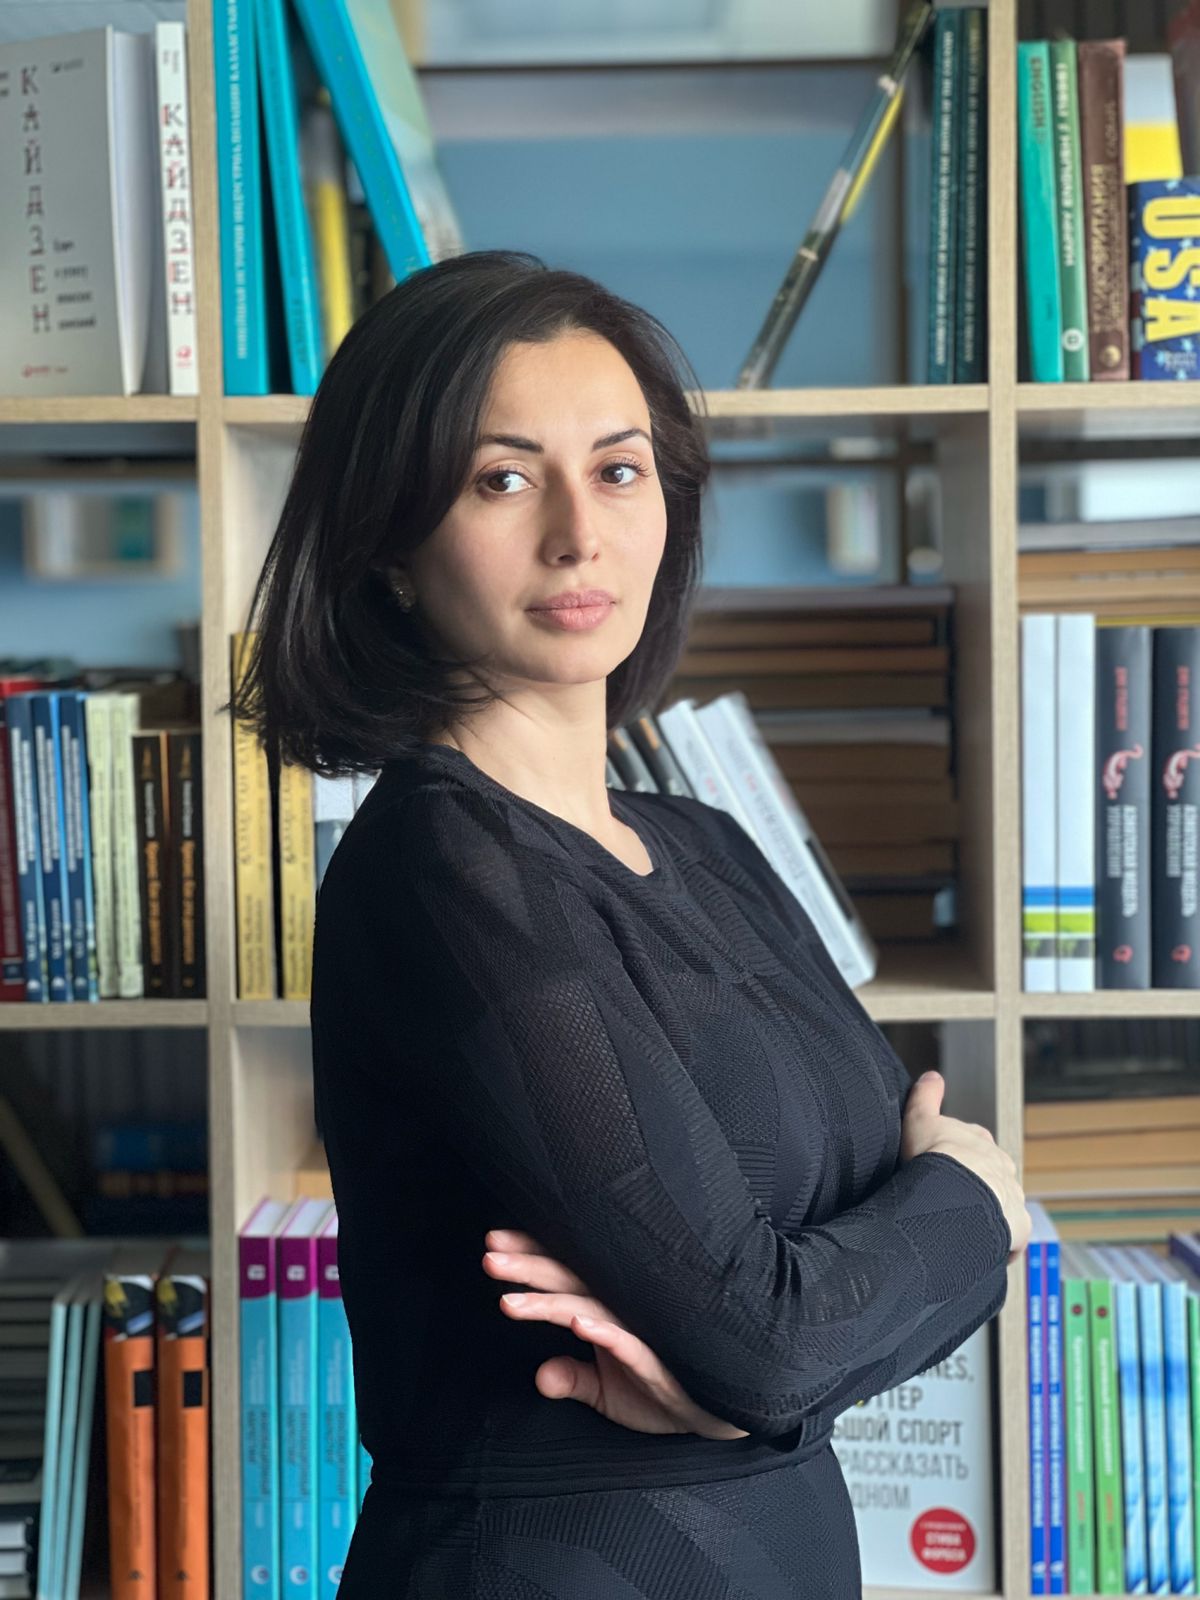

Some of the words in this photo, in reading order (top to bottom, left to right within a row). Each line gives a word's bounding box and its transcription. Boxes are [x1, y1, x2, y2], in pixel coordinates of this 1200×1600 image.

[1029, 57, 1046, 130] ENGLISH
[20, 64, 51, 333] КАЙДЗЕН
[1059, 135, 1075, 208] ENGLISH
[161, 104, 193, 315] КАЙДЗЕН
[1062, 210, 1076, 267] HAPPY
[1142, 196, 1200, 342] USA
[1122, 804, 1138, 867] АЗИАТСКАЯ
[1183, 804, 1198, 867] АЗИАТСКАЯ
[1121, 869, 1138, 917] МОДЕЛЬ
[1181, 869, 1198, 917] МОДЕЛЬ
[897, 1420, 964, 1447] СПОРТ
[839, 1449, 970, 1482] РАССКАЗАТЬ
[850, 1483, 912, 1510] ДНОМ
